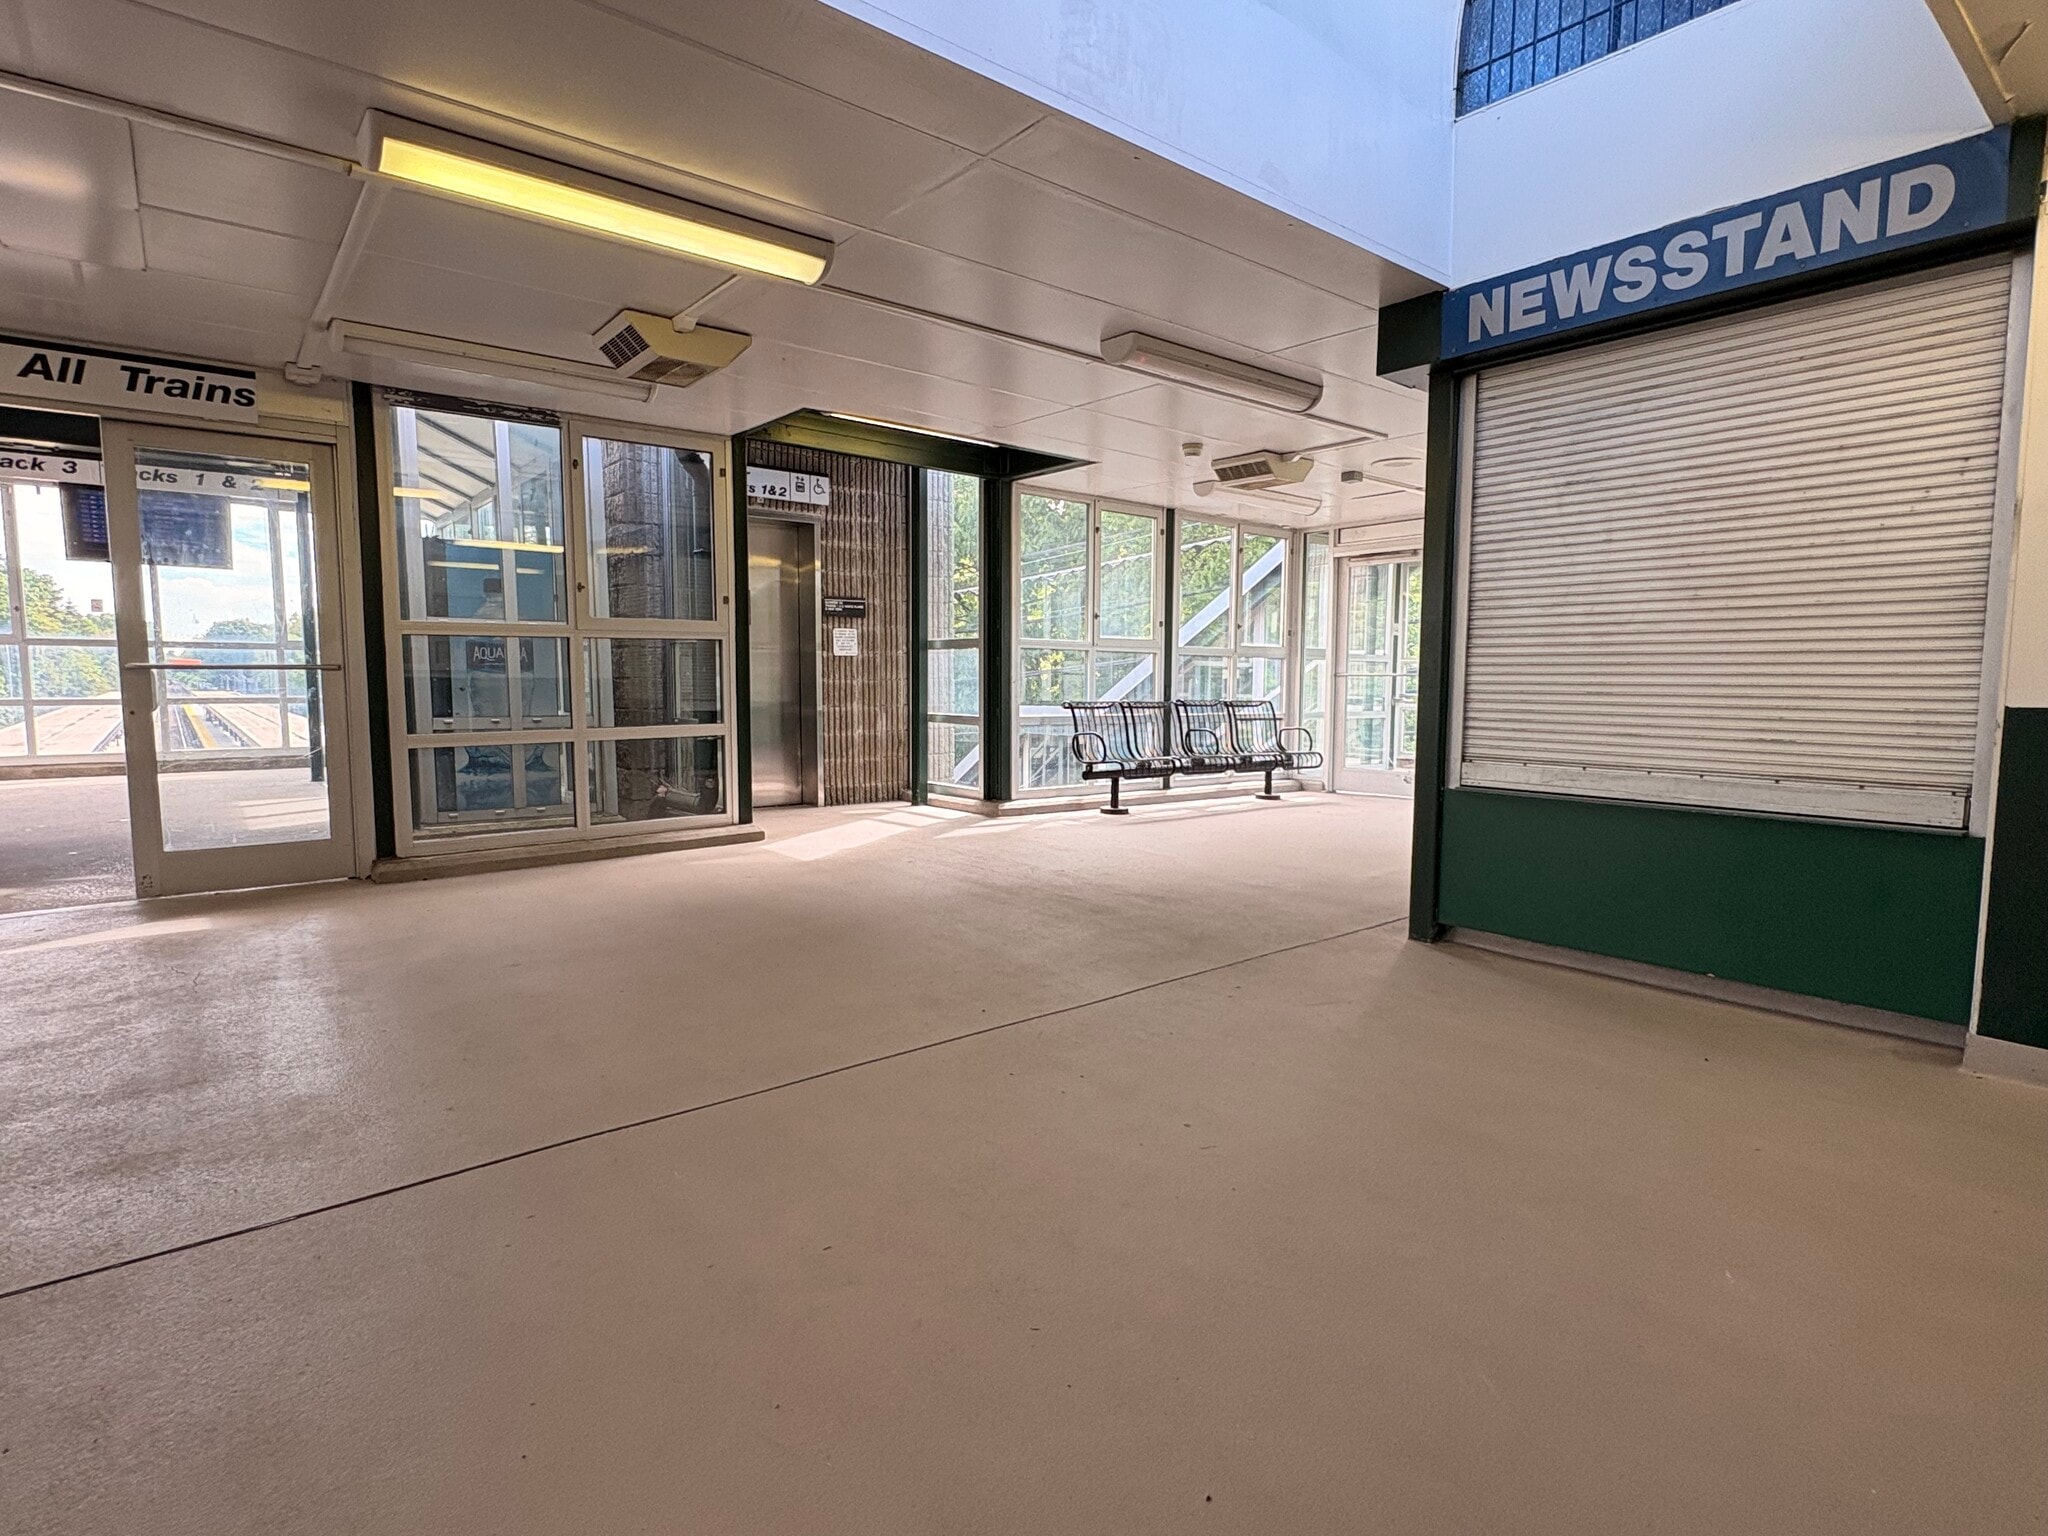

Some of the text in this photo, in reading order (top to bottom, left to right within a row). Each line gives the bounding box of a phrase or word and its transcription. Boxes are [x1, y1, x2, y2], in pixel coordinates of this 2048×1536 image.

[1467, 163, 1956, 344] NEWSSTAND
[17, 353, 256, 407] All Trains
[62, 460, 78, 474] 3
[195, 473, 205, 486] 1
[221, 475, 237, 489] &
[250, 479, 264, 491] 2
[473, 646, 529, 662] AQUAA
